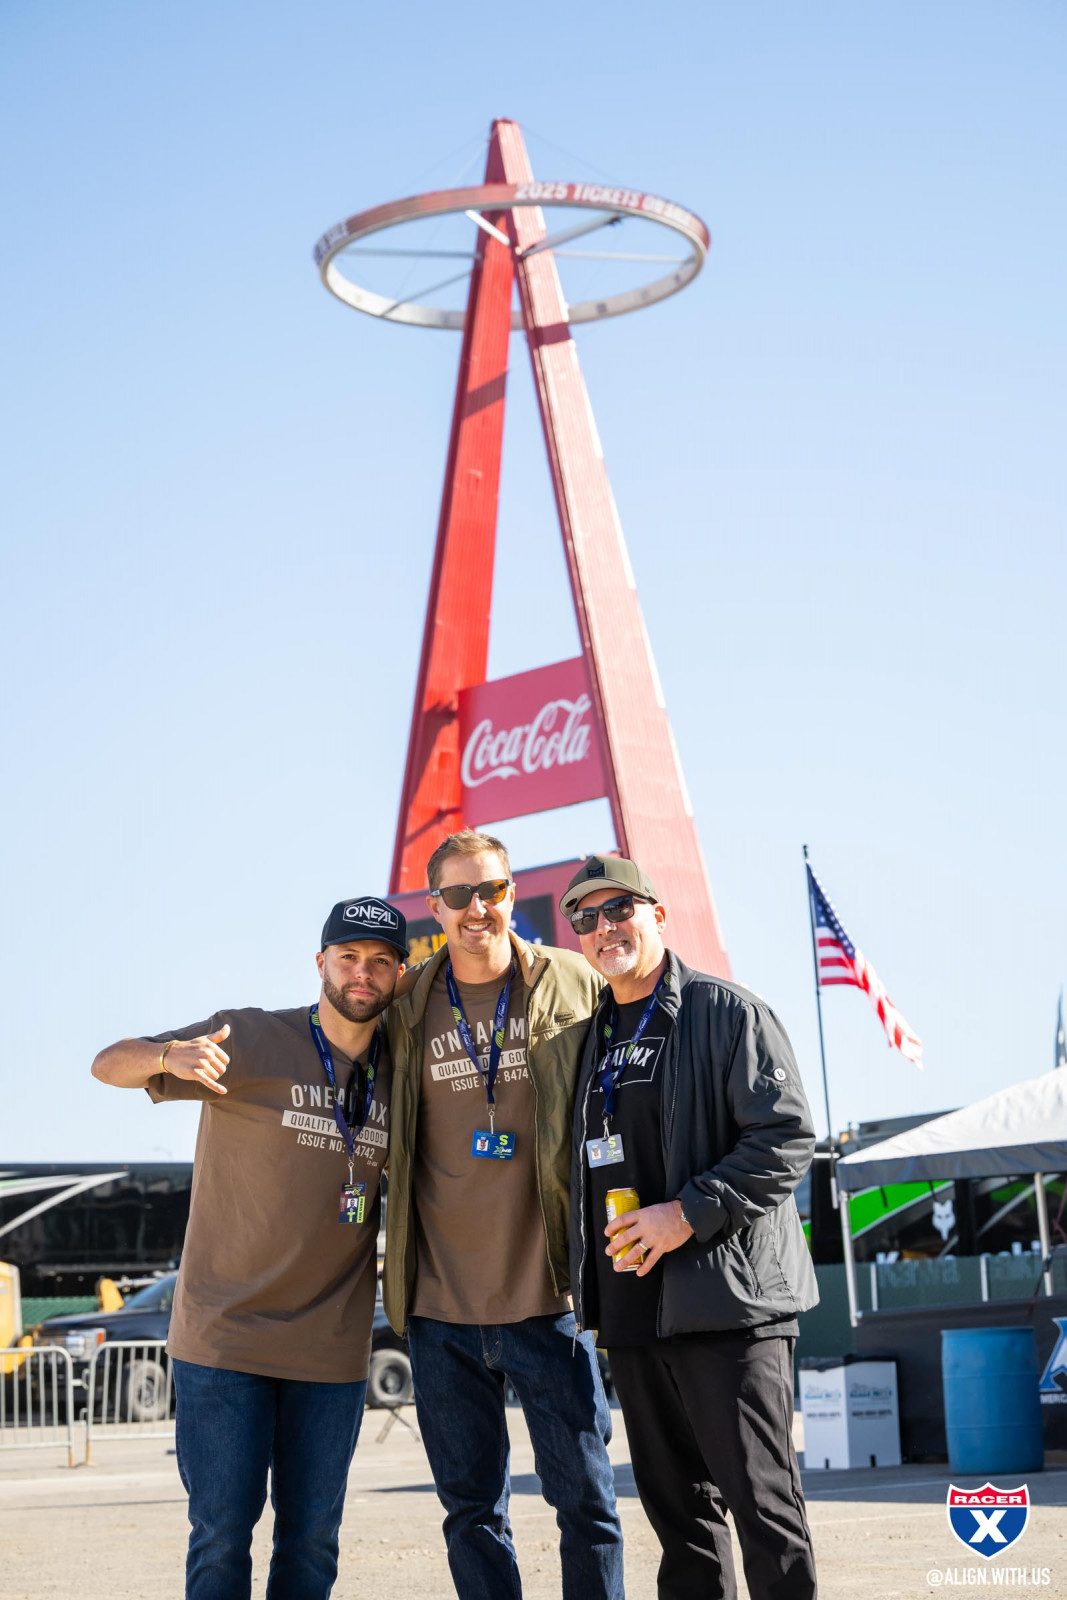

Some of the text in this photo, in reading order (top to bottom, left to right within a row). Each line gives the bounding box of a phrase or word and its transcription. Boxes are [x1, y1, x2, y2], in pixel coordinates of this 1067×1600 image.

[514, 183, 568, 200] 2025
[573, 184, 641, 208] TICKETS
[461, 693, 592, 788] Coca-Cola
[438, 1060, 473, 1077] QUALIT
[451, 1076, 479, 1092] ISSUE
[290, 1114, 333, 1132] QUALITY
[297, 1132, 376, 1160] ISSUE NO: 4742
[499, 1134, 509, 1146] S
